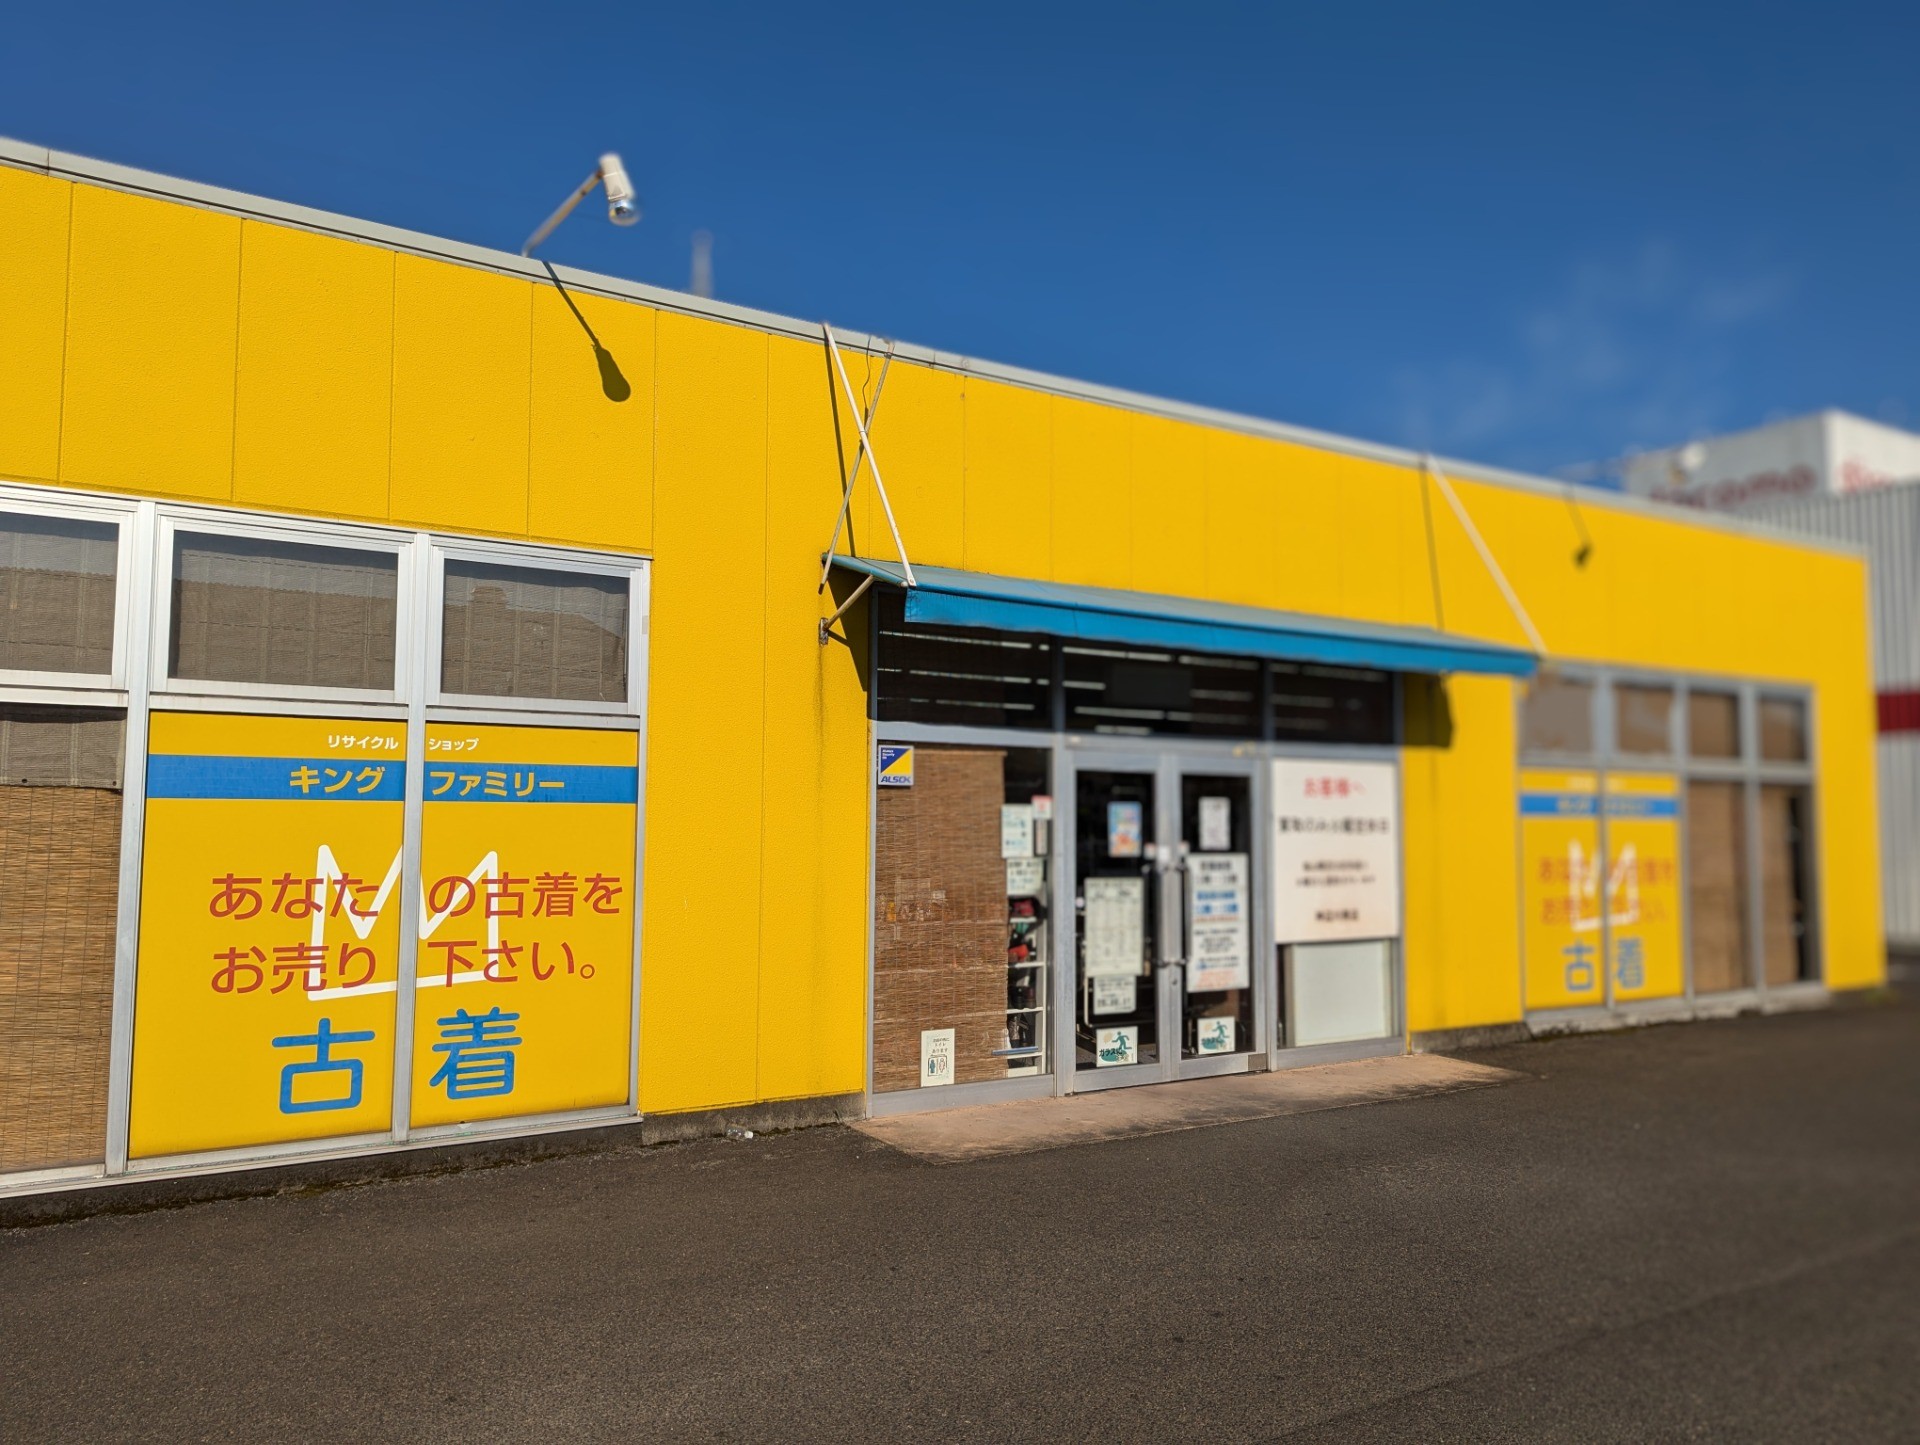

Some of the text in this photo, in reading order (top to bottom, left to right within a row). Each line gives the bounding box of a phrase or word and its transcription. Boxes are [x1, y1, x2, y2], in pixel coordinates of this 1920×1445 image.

[208, 871, 624, 921] あなた の古着を
[211, 940, 597, 995] お売り 下さい。
[271, 1006, 523, 1114] 古 着
